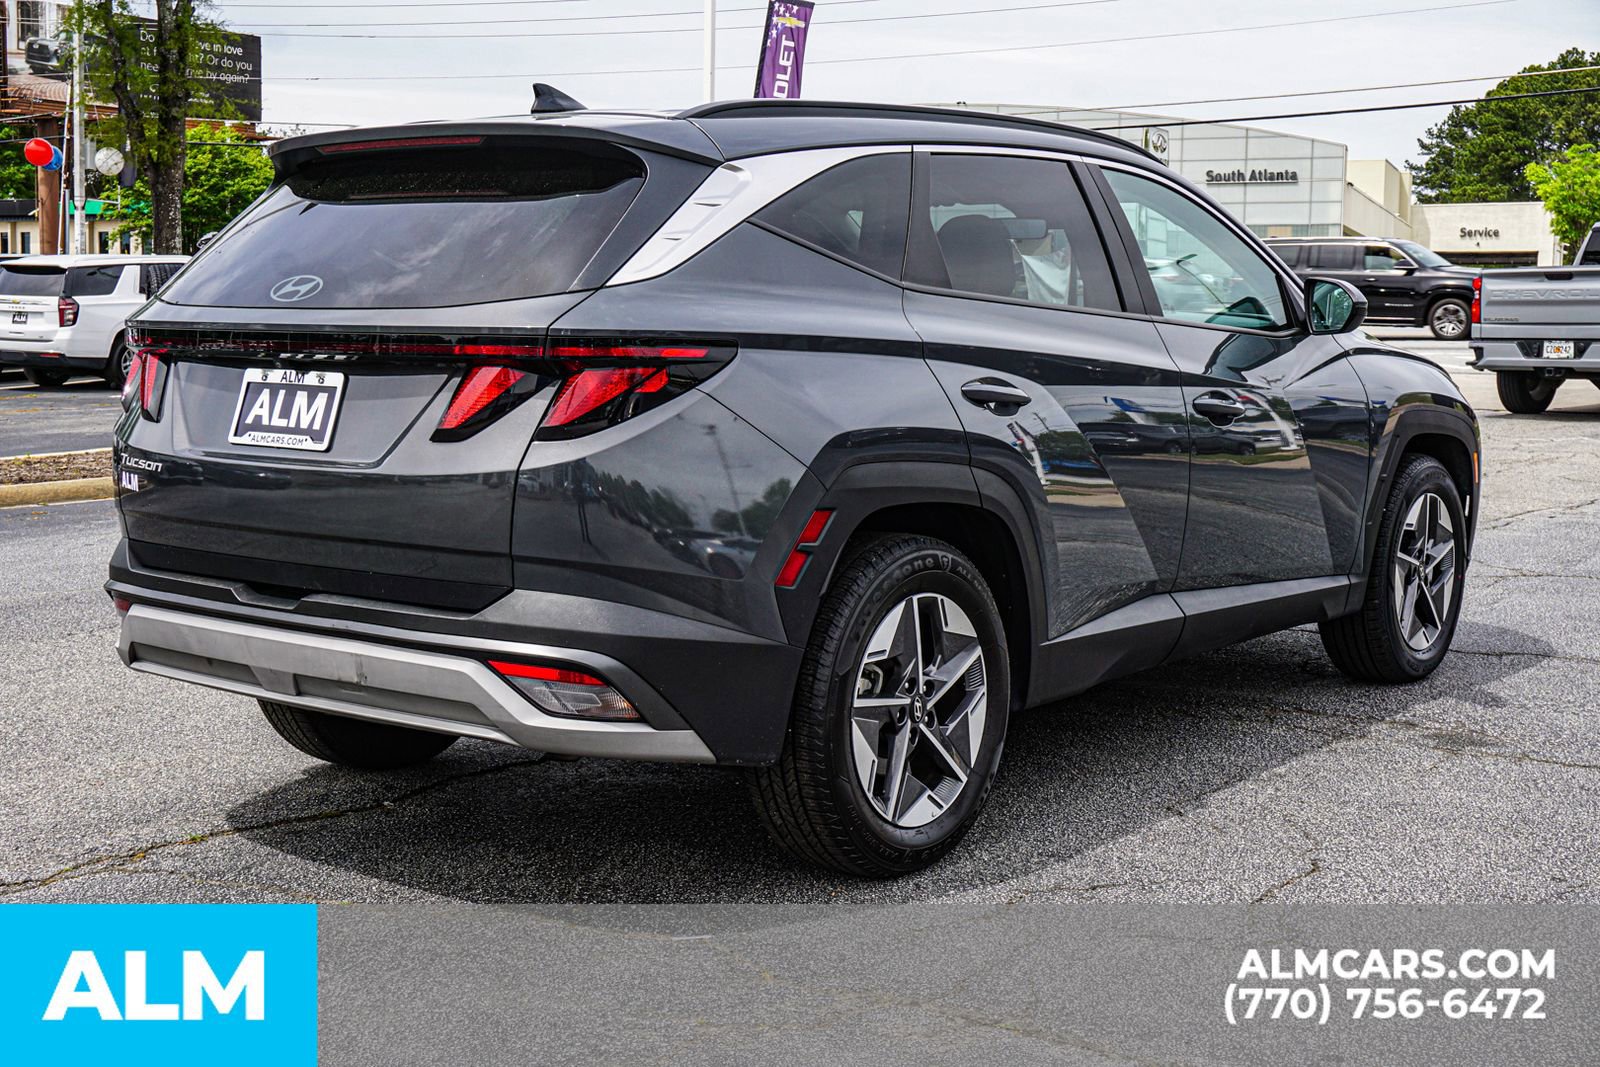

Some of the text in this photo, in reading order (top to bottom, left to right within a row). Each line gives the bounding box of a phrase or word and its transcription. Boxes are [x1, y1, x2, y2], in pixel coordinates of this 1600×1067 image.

[140, 30, 155, 42] Do
[224, 43, 243, 57] love
[207, 54, 219, 66] Or
[221, 56, 234, 68] do
[235, 61, 253, 72] you
[140, 61, 159, 72] nee
[220, 71, 250, 84] again?
[1206, 168, 1298, 182] South Atlanta
[1460, 227, 1500, 238] Service
[280, 371, 305, 384] ALM
[245, 388, 328, 430] ALM
[251, 434, 304, 446] ALMCARS.COM
[122, 471, 139, 492] ALM
